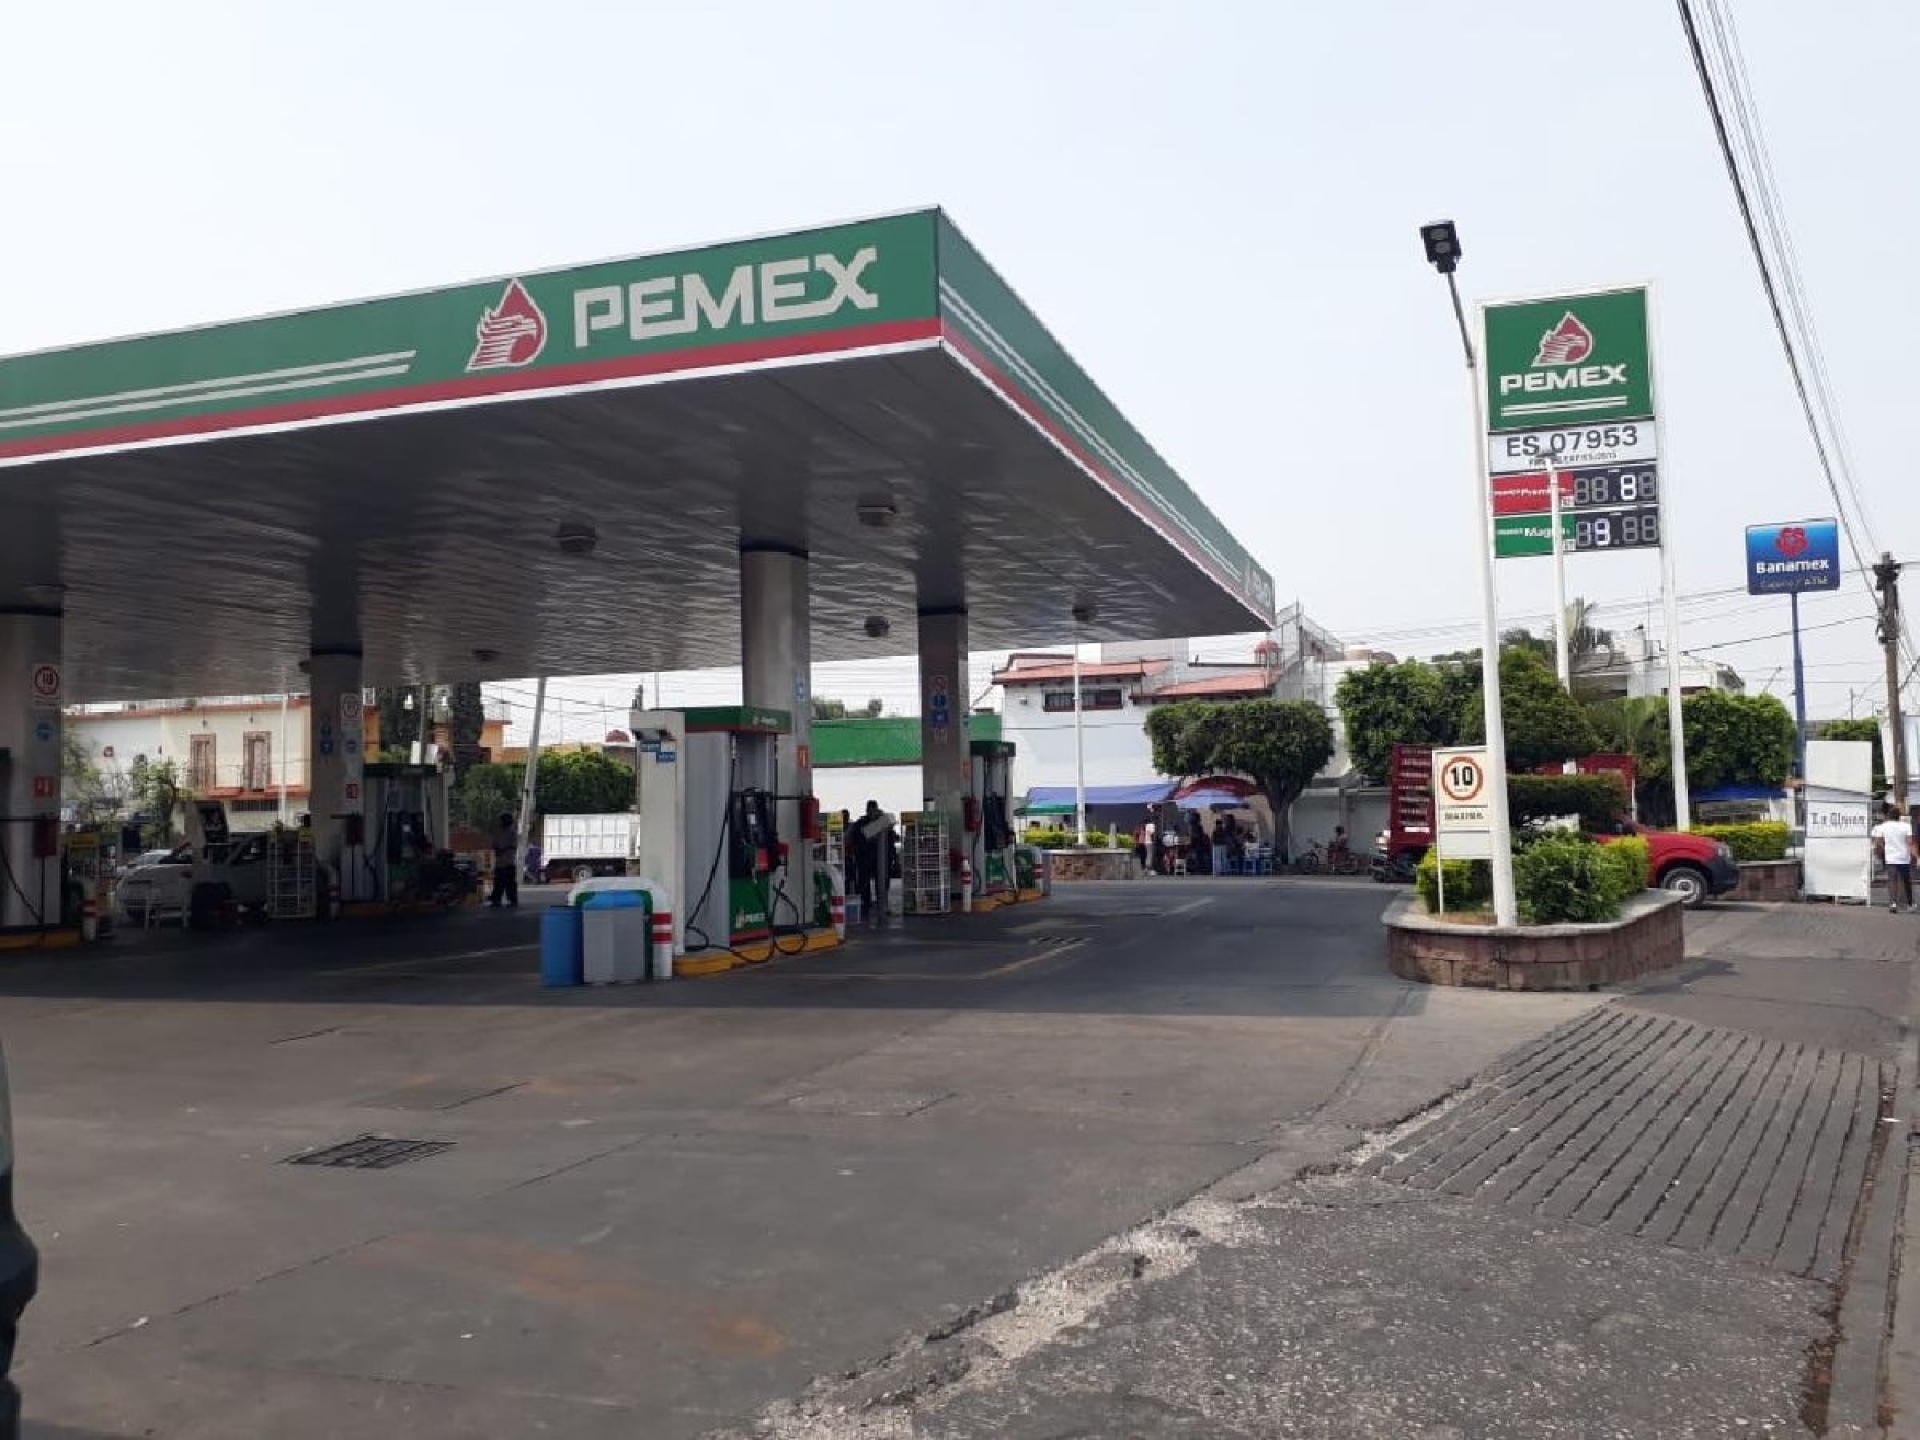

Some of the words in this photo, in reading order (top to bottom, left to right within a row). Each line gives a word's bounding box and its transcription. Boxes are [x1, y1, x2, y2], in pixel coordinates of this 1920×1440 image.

[574, 246, 878, 348] PEMEX
[1500, 363, 1628, 396] PEMEX
[1506, 435, 1540, 457] ES
[1550, 425, 1638, 454] 07953
[1756, 559, 1830, 574] Banamex
[1450, 765, 1474, 787] 10
